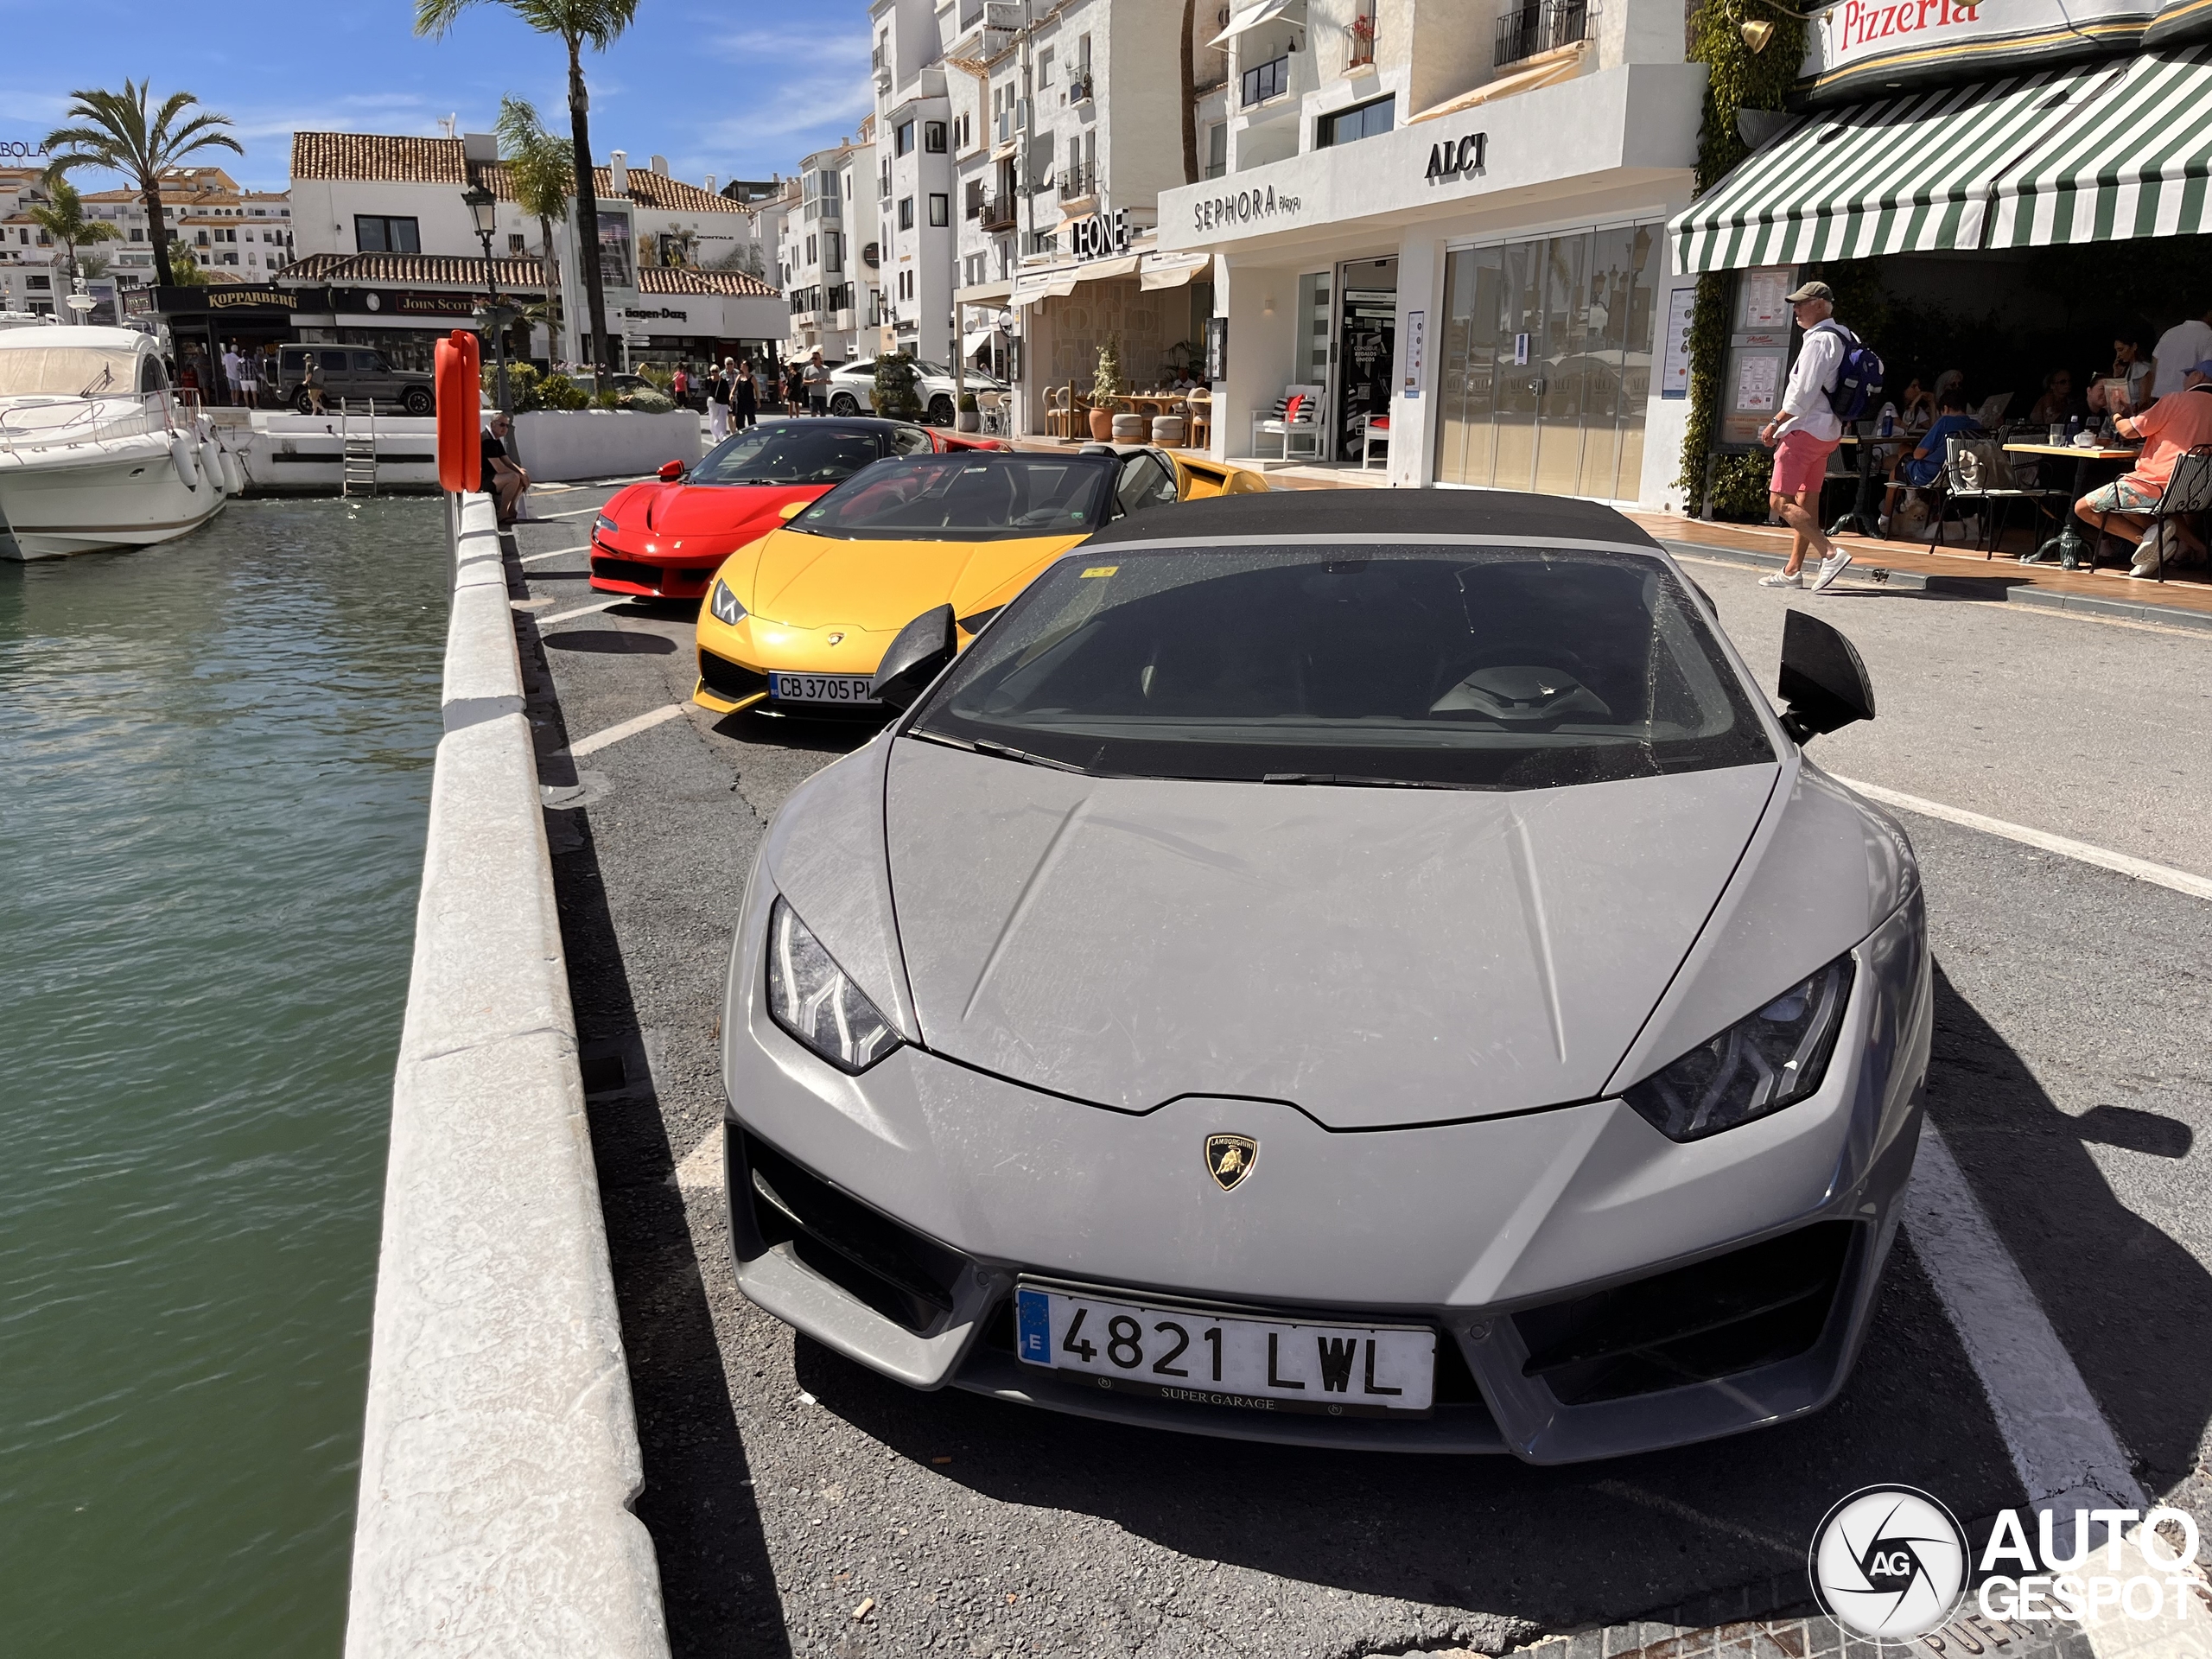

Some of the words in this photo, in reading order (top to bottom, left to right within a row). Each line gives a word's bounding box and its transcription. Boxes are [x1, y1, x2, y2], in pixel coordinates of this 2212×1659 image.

[1841, 0, 1980, 51] Pizzeria
[1424, 132, 1486, 179] ALCI
[1194, 184, 1275, 230] SEPHORA
[1072, 207, 1126, 259] LEONE
[208, 292, 298, 309] KOPPARBERG
[403, 298, 435, 309] JOHN
[780, 677, 803, 697] CB
[806, 679, 850, 699] 3705
[1211, 1138, 1254, 1150] LAMBORGHINI
[1029, 1334, 1041, 1350] E
[1063, 1307, 1222, 1382] 4821
[1268, 1332, 1402, 1395] LWL
[1161, 1387, 1208, 1403] SUPER
[1211, 1391, 1276, 1410] GARAGE
